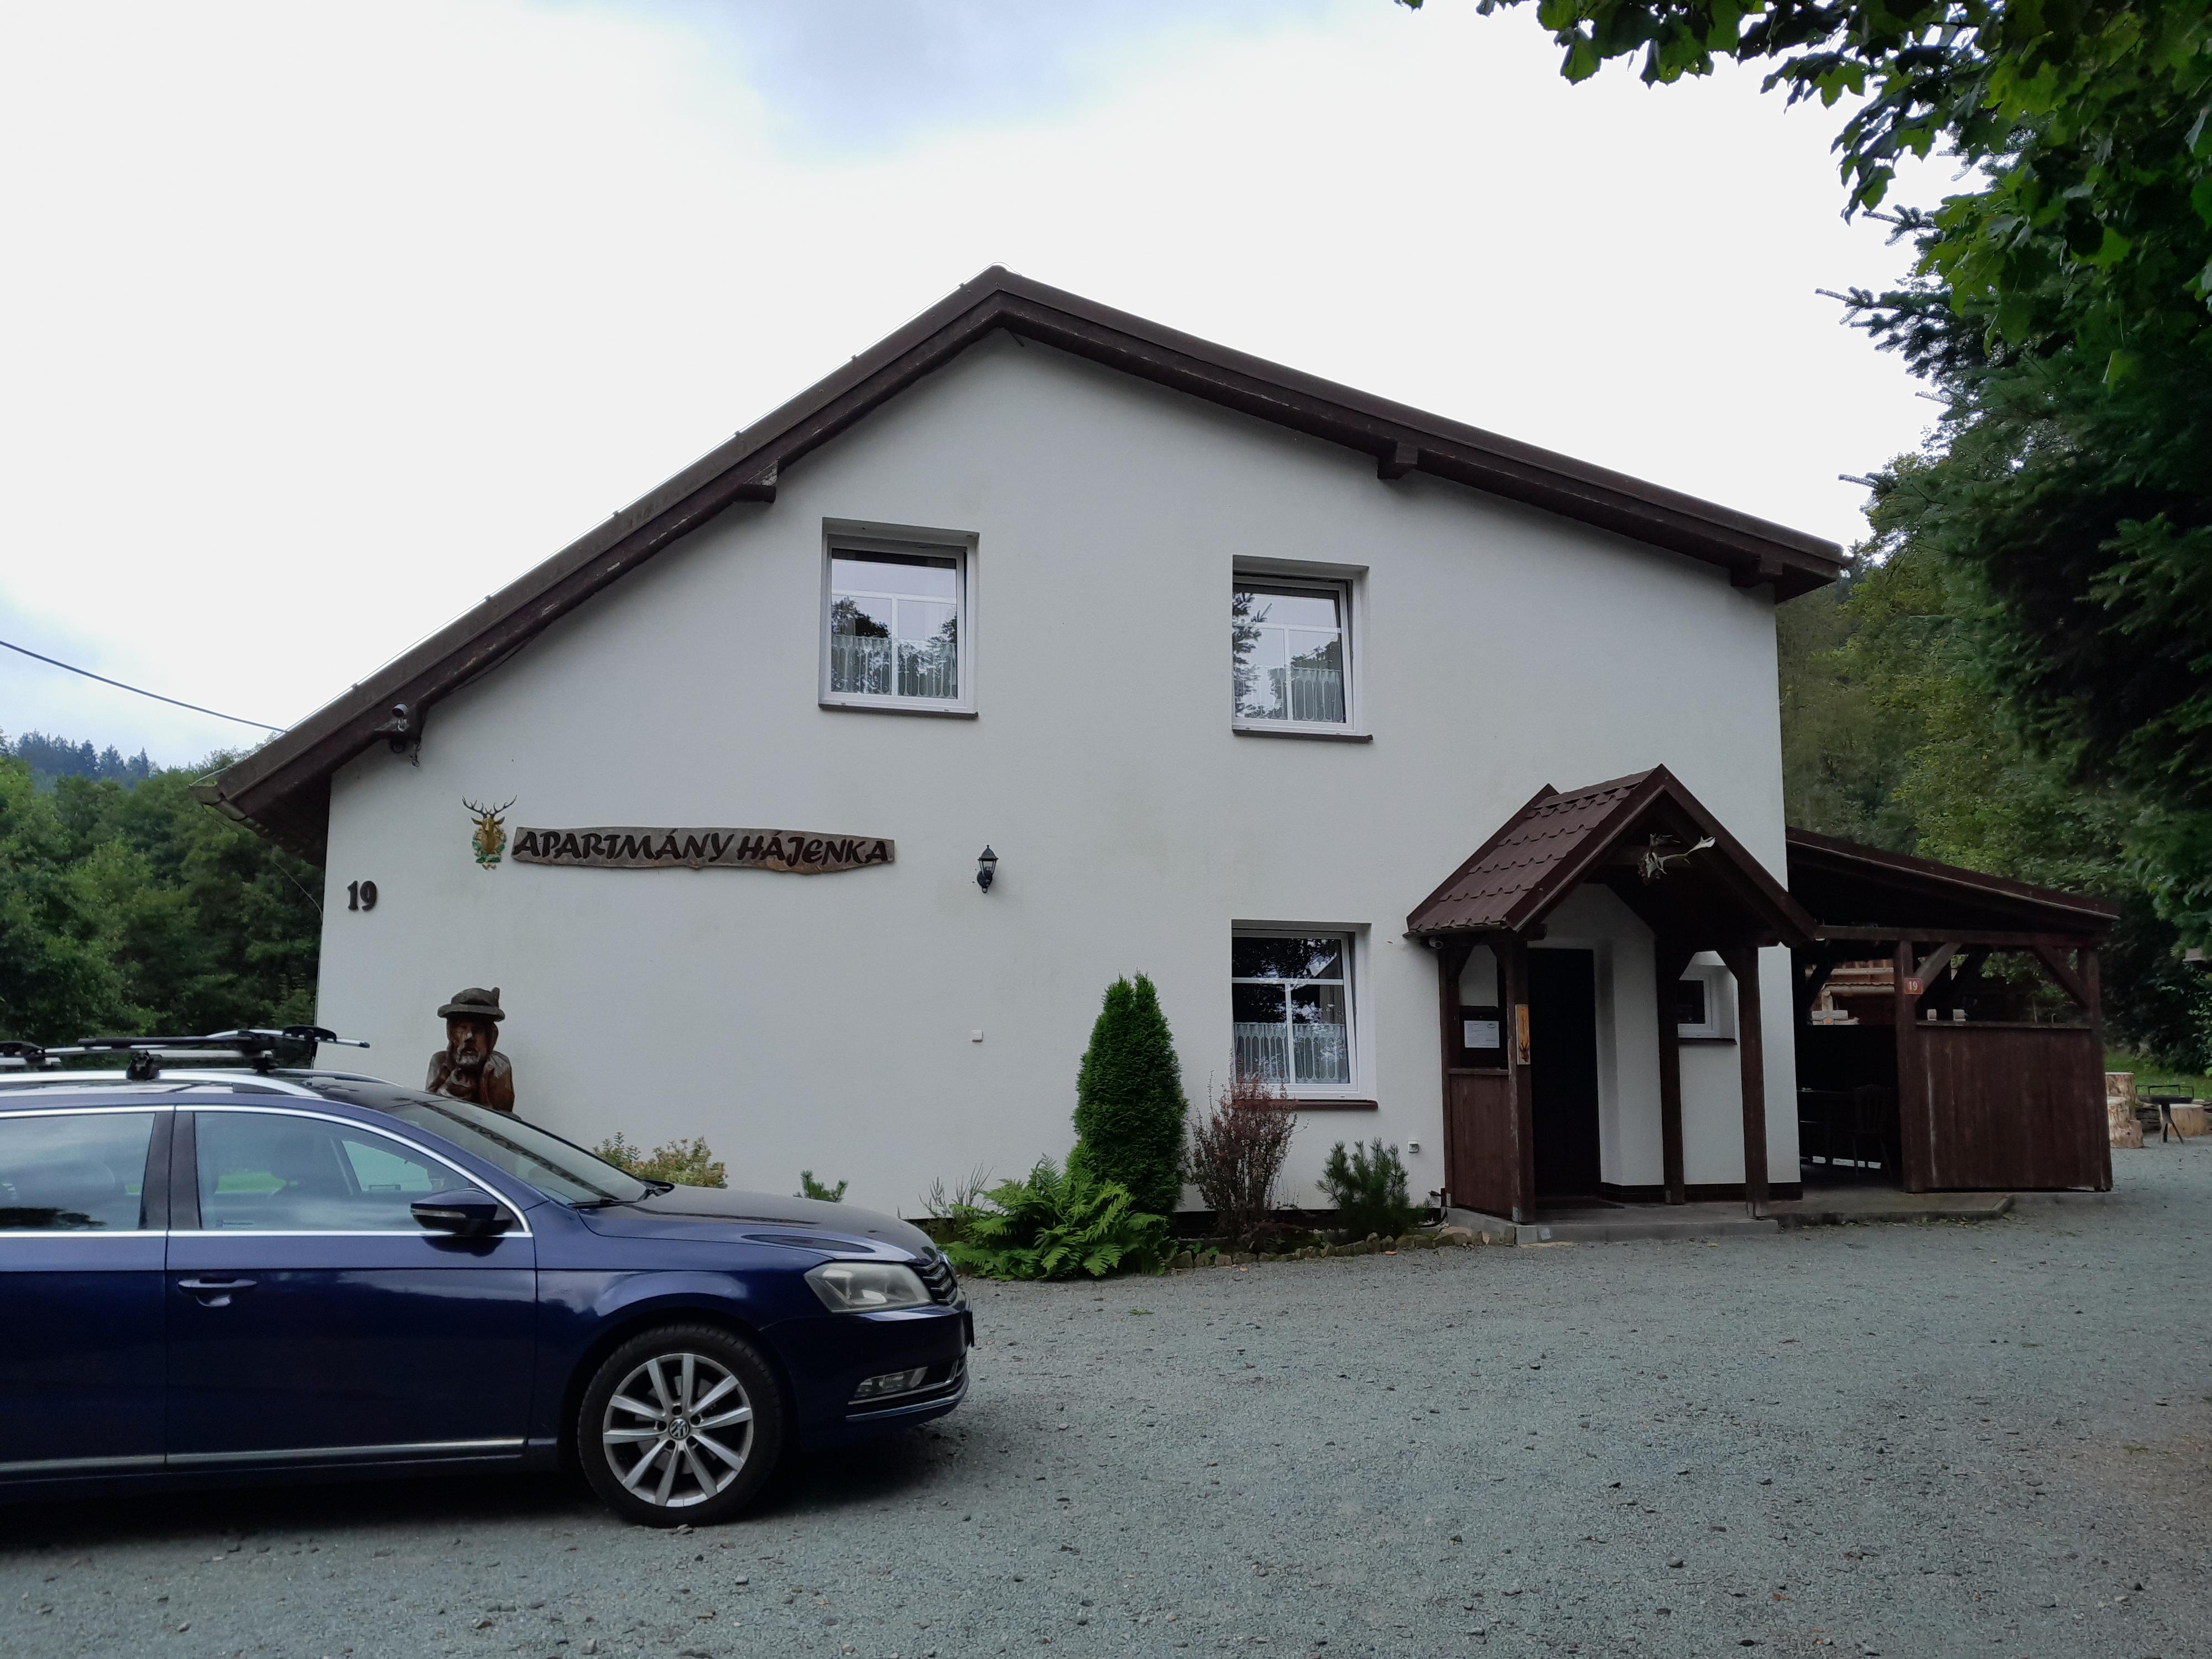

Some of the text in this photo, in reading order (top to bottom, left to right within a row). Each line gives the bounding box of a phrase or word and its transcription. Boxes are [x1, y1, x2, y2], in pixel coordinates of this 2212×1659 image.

[512, 828, 888, 867] APARTMÁNY HÁJENKA
[347, 880, 377, 911] 19
[1908, 981, 1918, 991] 19
